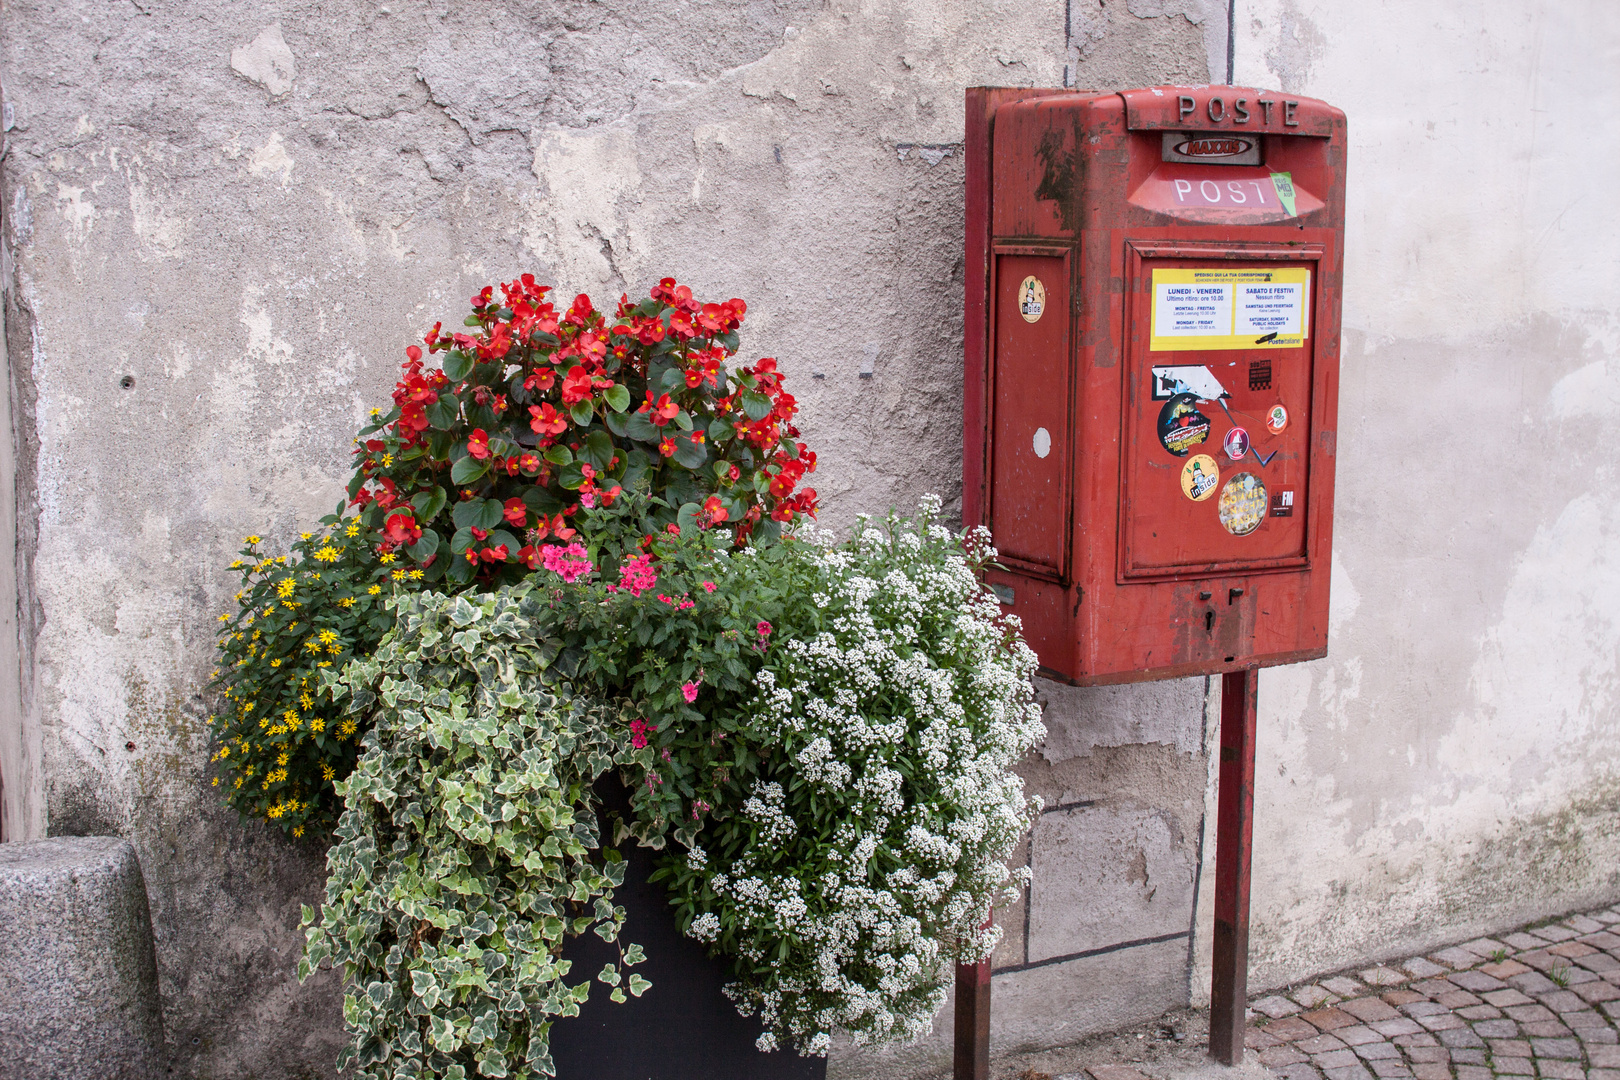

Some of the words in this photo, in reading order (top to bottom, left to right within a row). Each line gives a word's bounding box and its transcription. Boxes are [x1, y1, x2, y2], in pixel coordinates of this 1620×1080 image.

[1177, 95, 1299, 126] POSTE
[1186, 140, 1241, 155] MAXXIS
[1022, 304, 1040, 312] inside
[1190, 477, 1216, 498] inside
[1229, 481, 1244, 493] EIN
[1224, 486, 1264, 506] SOMMER
[1230, 499, 1264, 514] NACHTS
[1228, 513, 1257, 528] TRAUM
